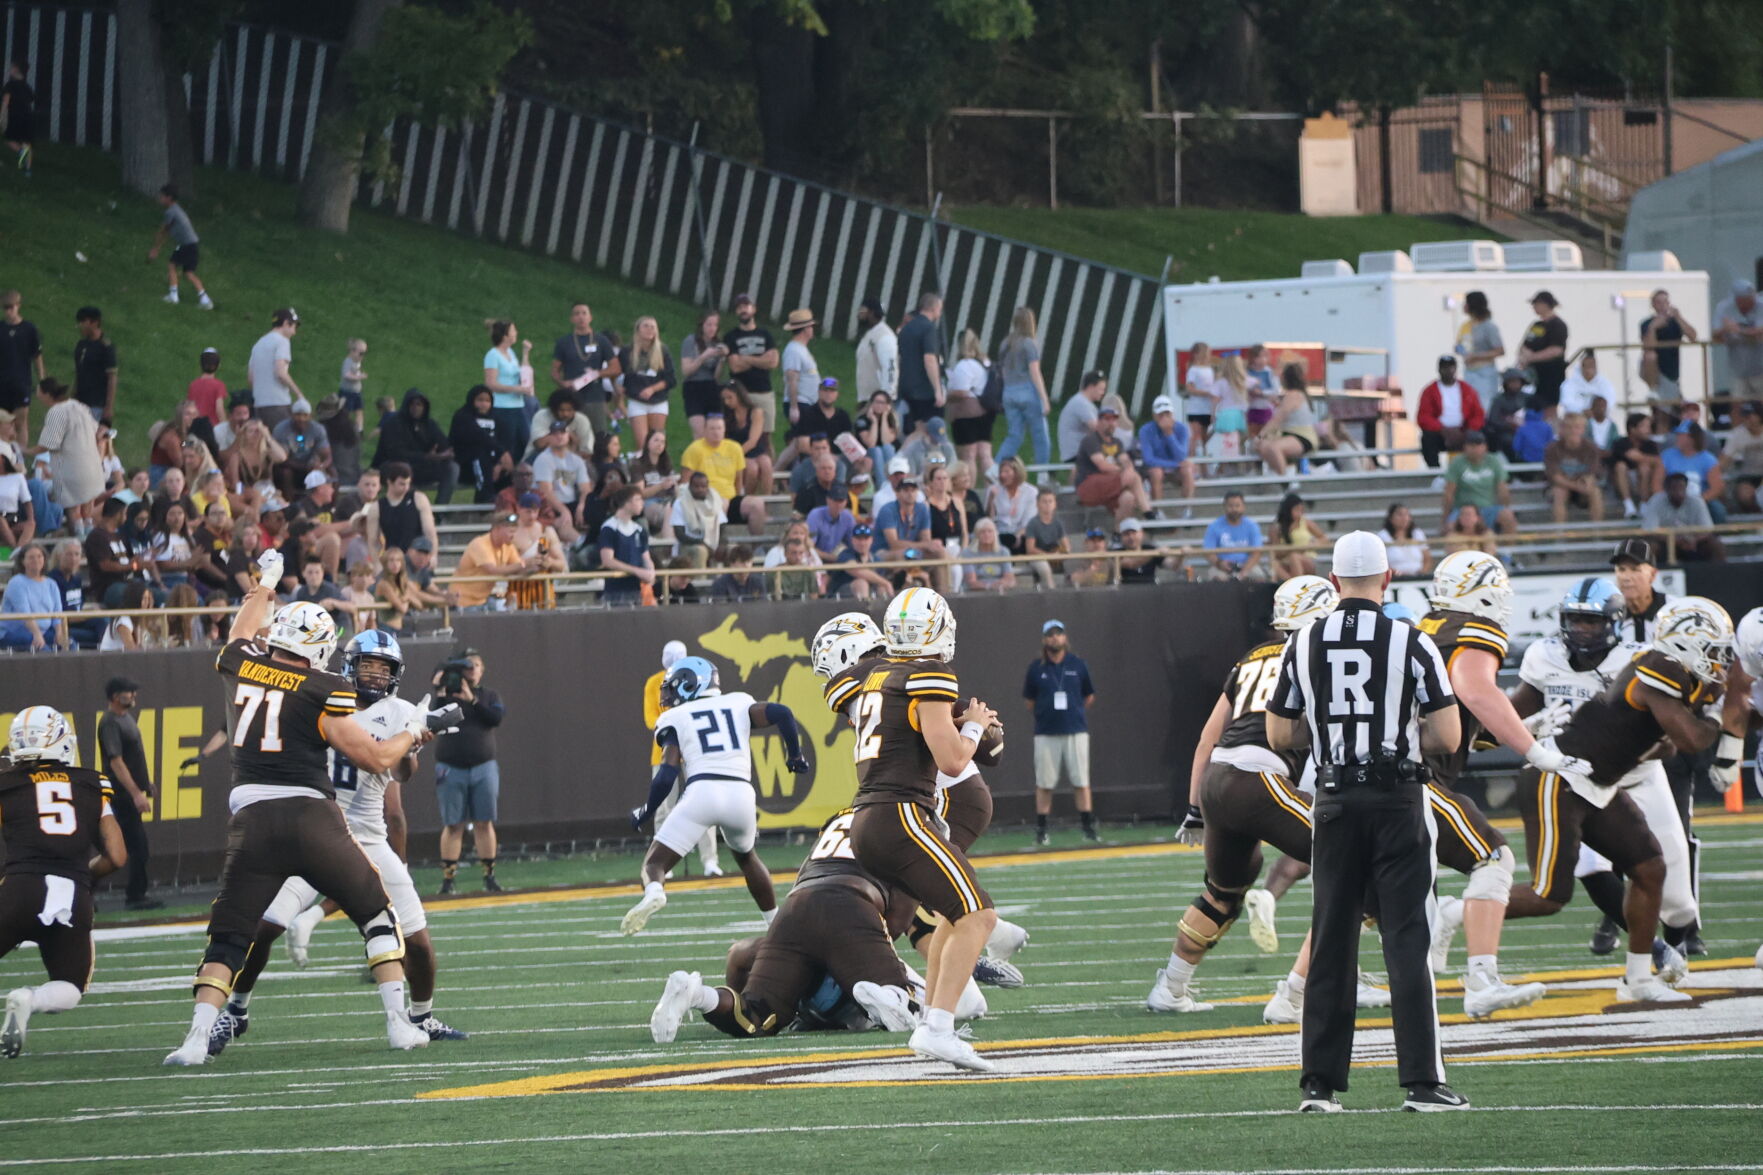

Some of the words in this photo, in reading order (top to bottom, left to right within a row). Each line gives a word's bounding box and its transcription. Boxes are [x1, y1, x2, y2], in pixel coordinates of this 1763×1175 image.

[238, 659, 308, 692] VANDERVEST
[1326, 648, 1375, 716] R
[233, 683, 285, 752] 71
[690, 707, 742, 754] 21
[28, 771, 70, 783] MILES
[751, 735, 802, 798] W
[35, 781, 77, 835] 5
